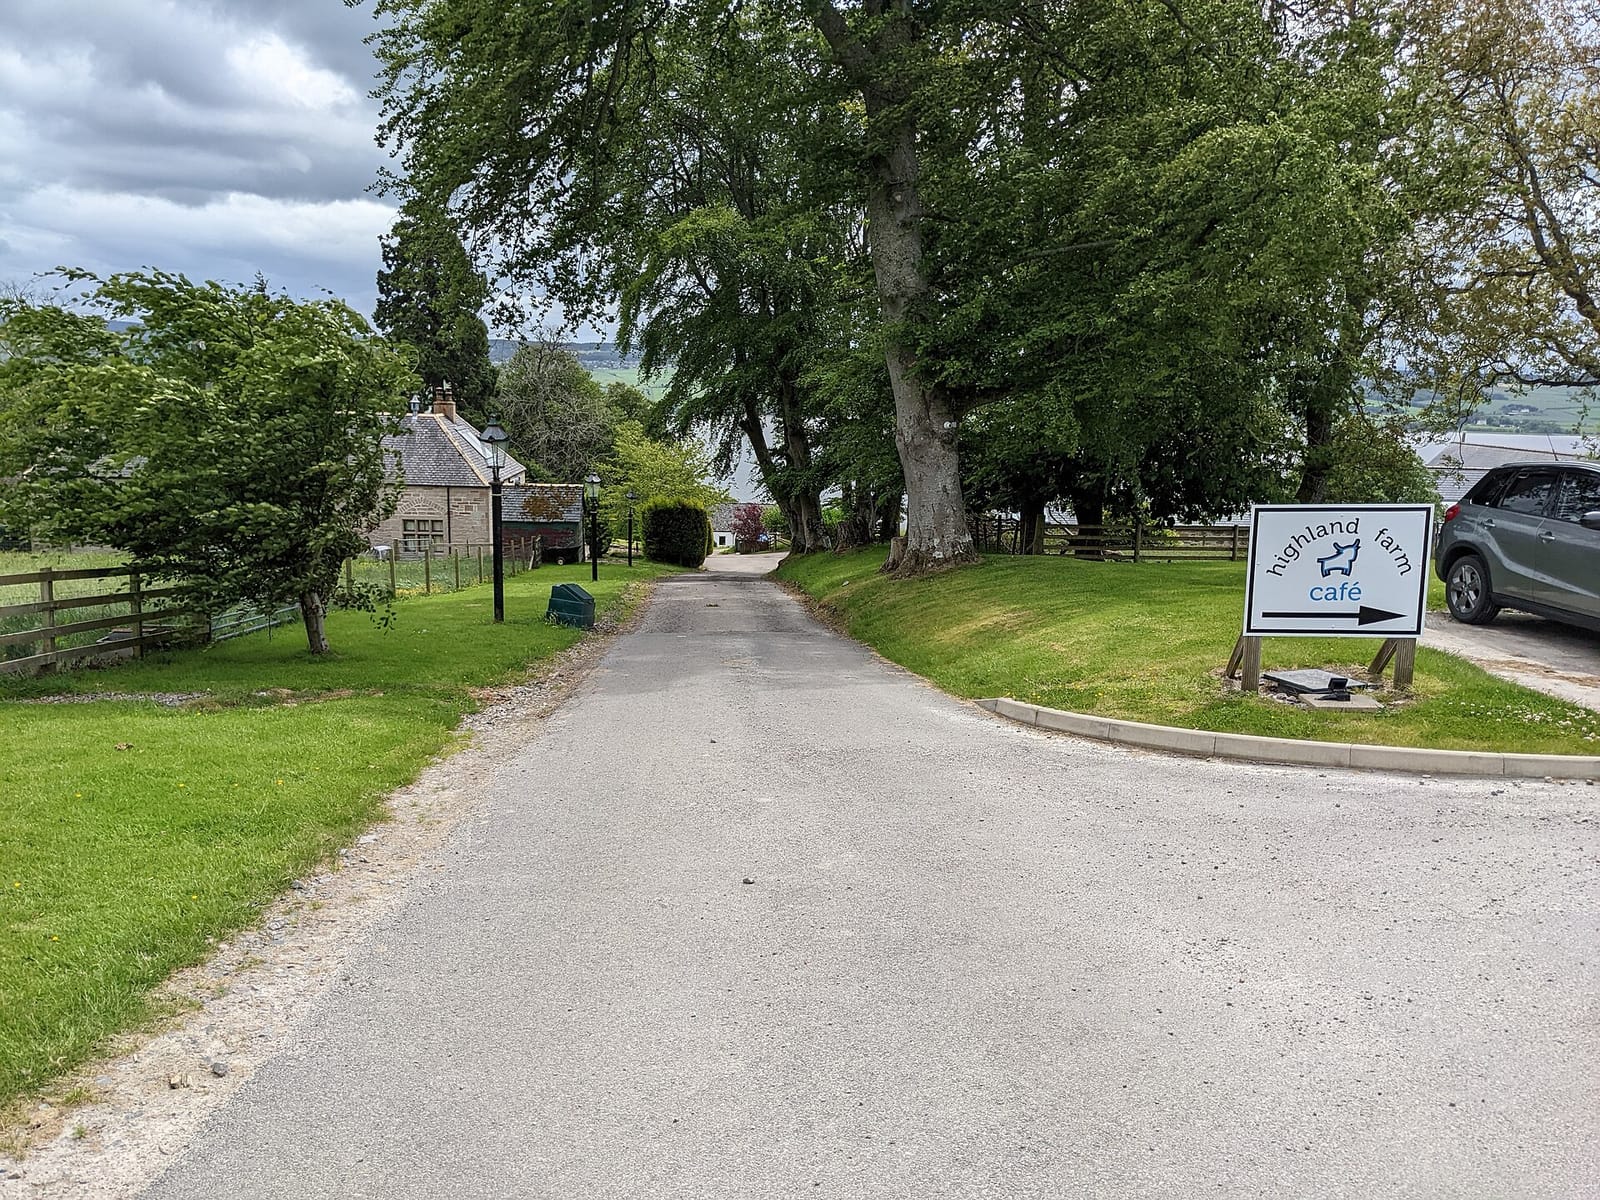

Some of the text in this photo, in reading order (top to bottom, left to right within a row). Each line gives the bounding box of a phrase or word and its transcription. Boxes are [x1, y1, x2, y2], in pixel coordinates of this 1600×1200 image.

[1266, 518, 1412, 577] highland farm
[1309, 582, 1362, 601] café
